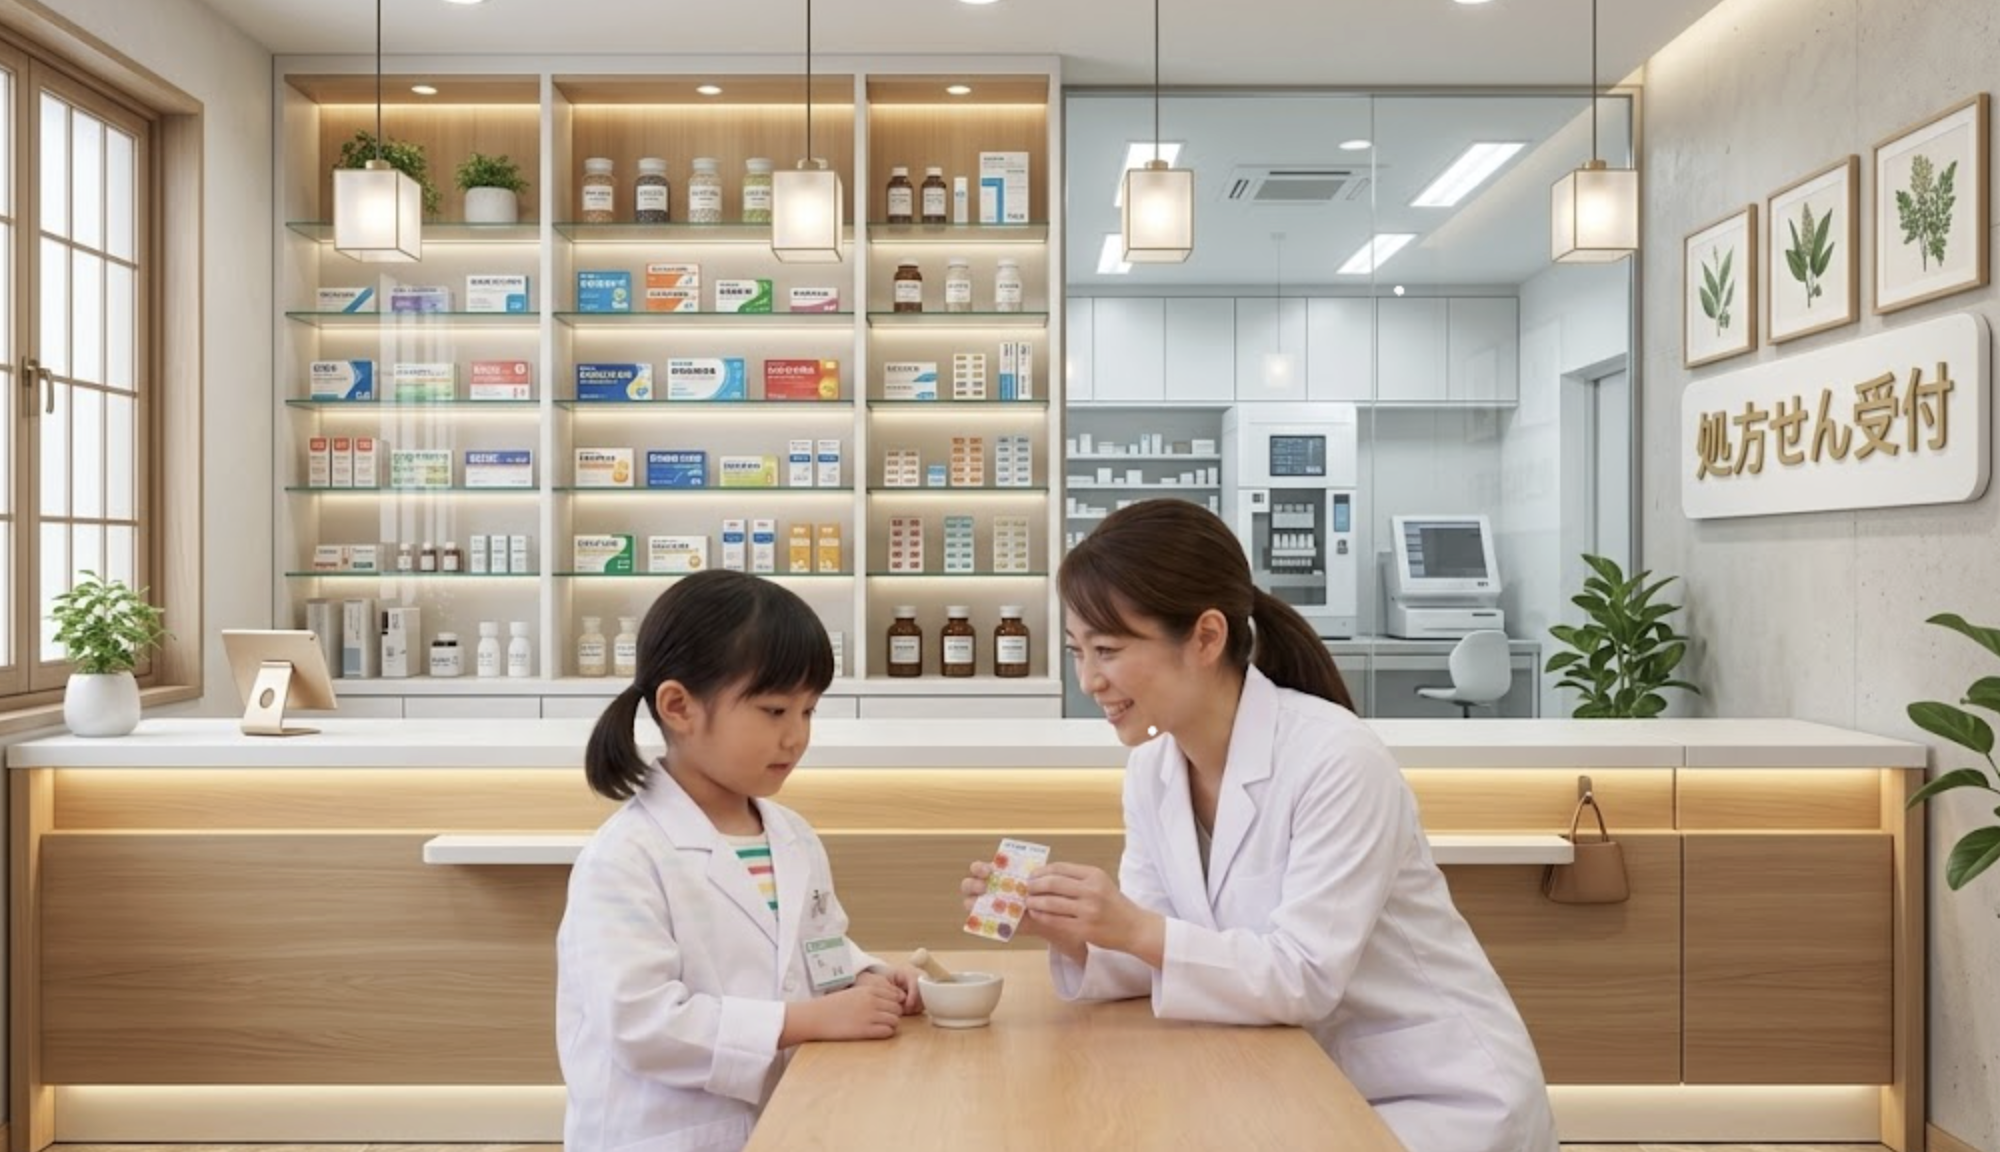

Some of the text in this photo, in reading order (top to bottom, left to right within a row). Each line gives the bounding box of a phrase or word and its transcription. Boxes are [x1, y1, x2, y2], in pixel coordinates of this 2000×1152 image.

[1697, 362, 1954, 480] 処方せん受付
